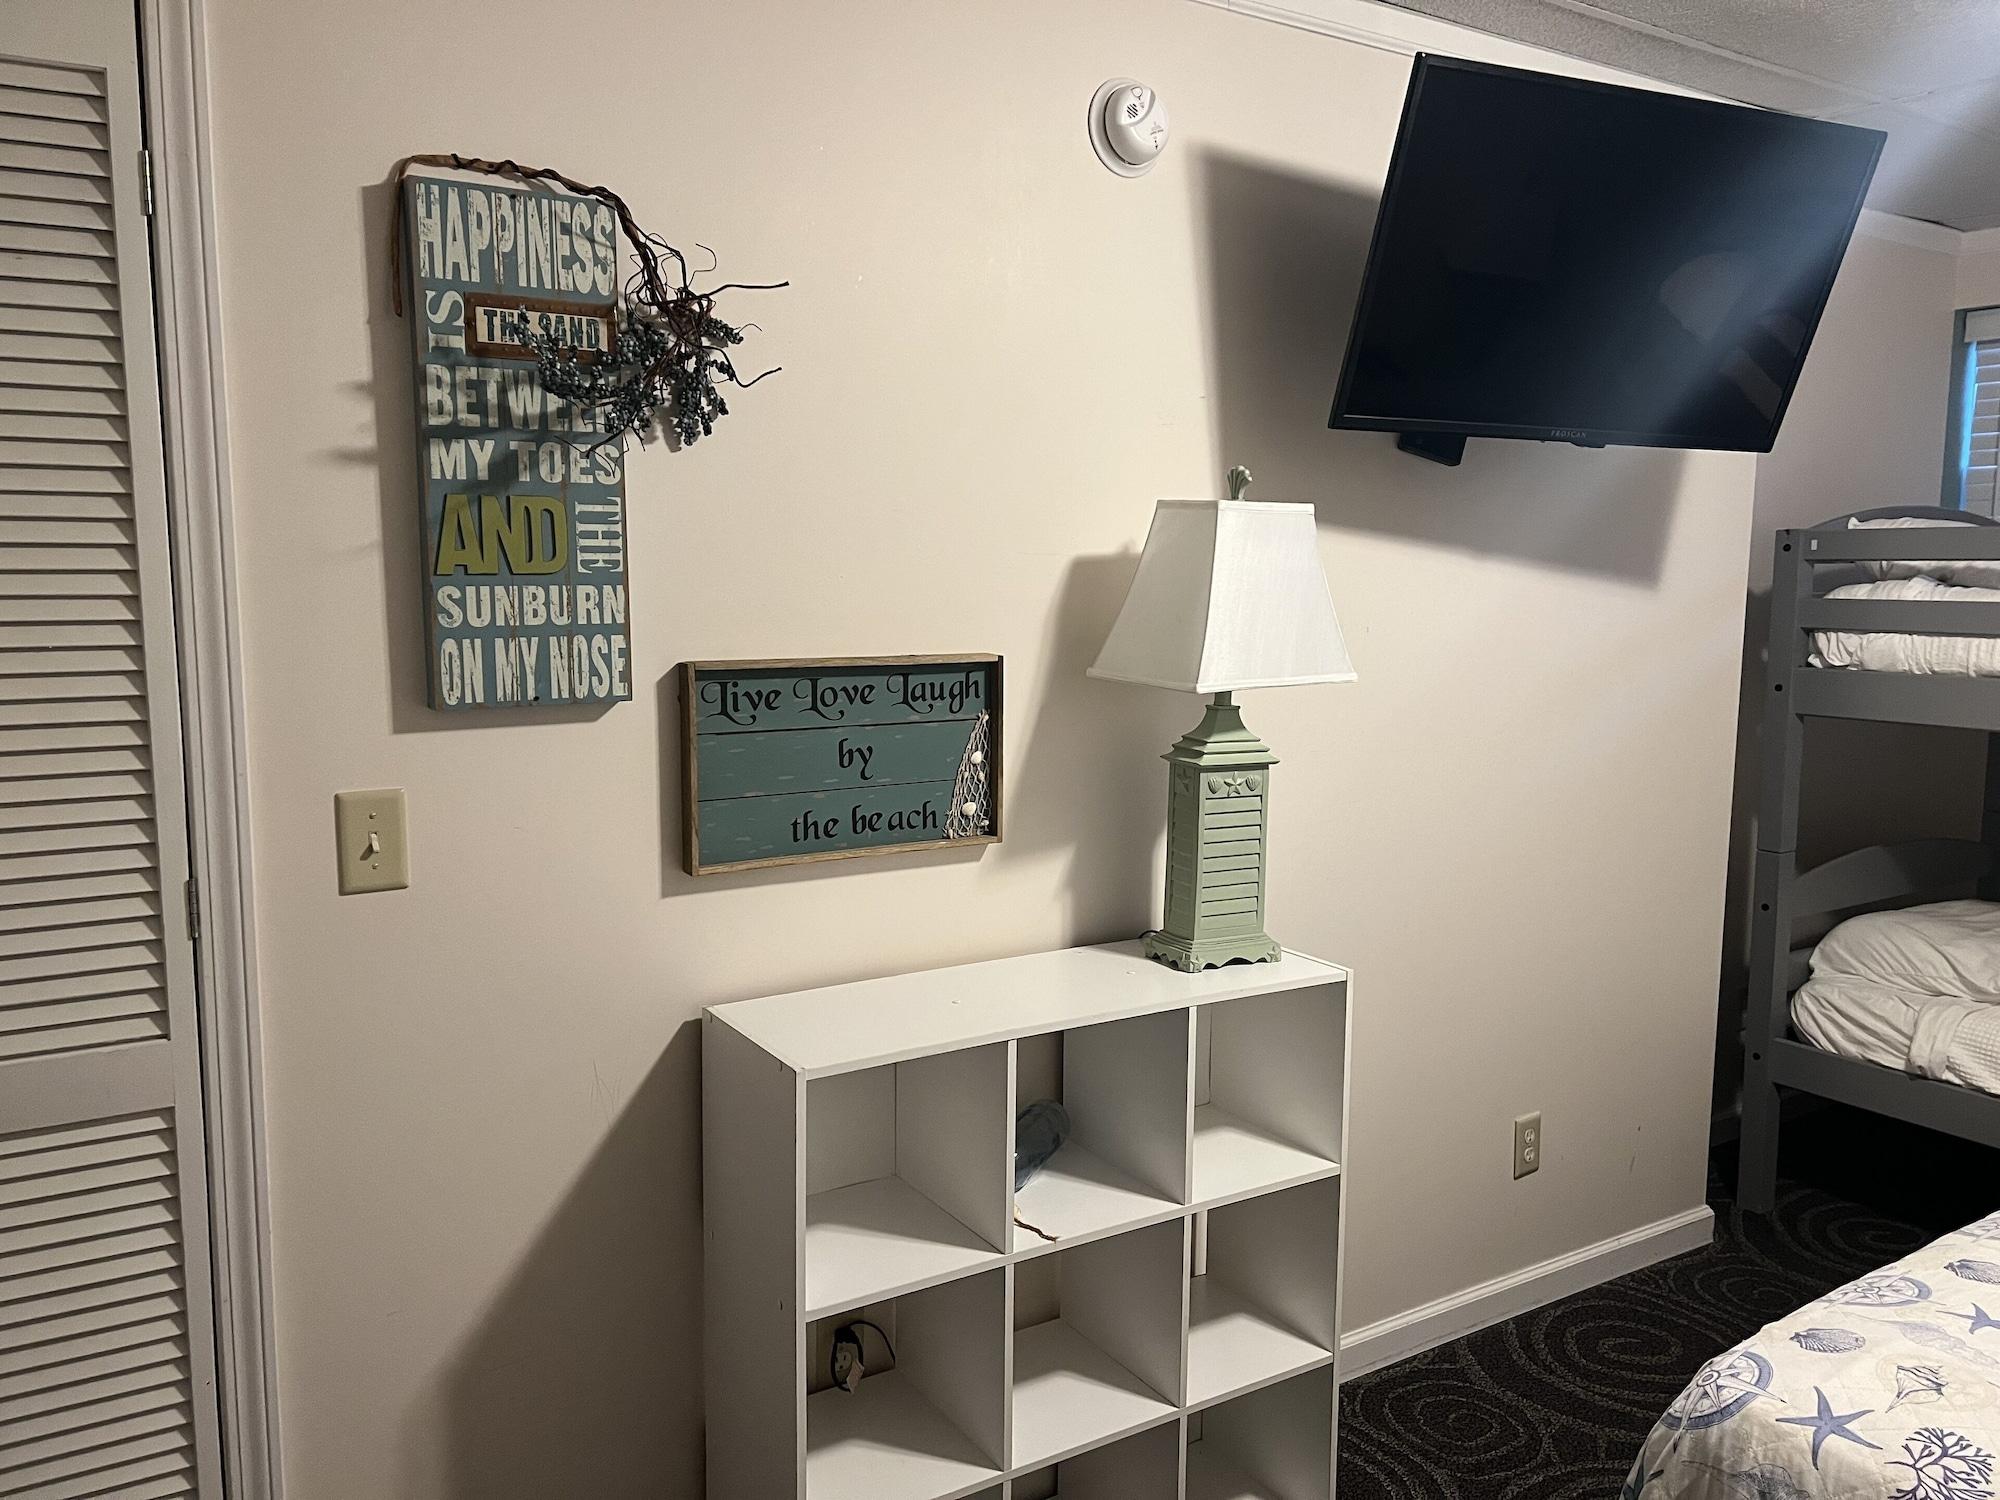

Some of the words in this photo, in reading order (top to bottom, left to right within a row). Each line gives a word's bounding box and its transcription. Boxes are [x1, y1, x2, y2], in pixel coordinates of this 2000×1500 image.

[416, 183, 615, 296] HAPPINESS
[426, 290, 466, 355] IS
[538, 312, 600, 348] SAND
[1551, 430, 1587, 439] PROSCAN
[429, 438, 495, 481] MY
[510, 440, 622, 485] TOES
[433, 494, 569, 576] AND
[575, 496, 624, 575] THE
[437, 584, 626, 629] SUNBURN
[440, 638, 484, 706] ON
[495, 636, 539, 702] MY
[550, 633, 629, 700] NOSE
[701, 680, 782, 726] Live
[793, 677, 876, 721] Love
[886, 670, 981, 715] Laugh
[838, 737, 874, 781] by
[791, 809, 840, 843] the
[851, 800, 939, 835] beach
